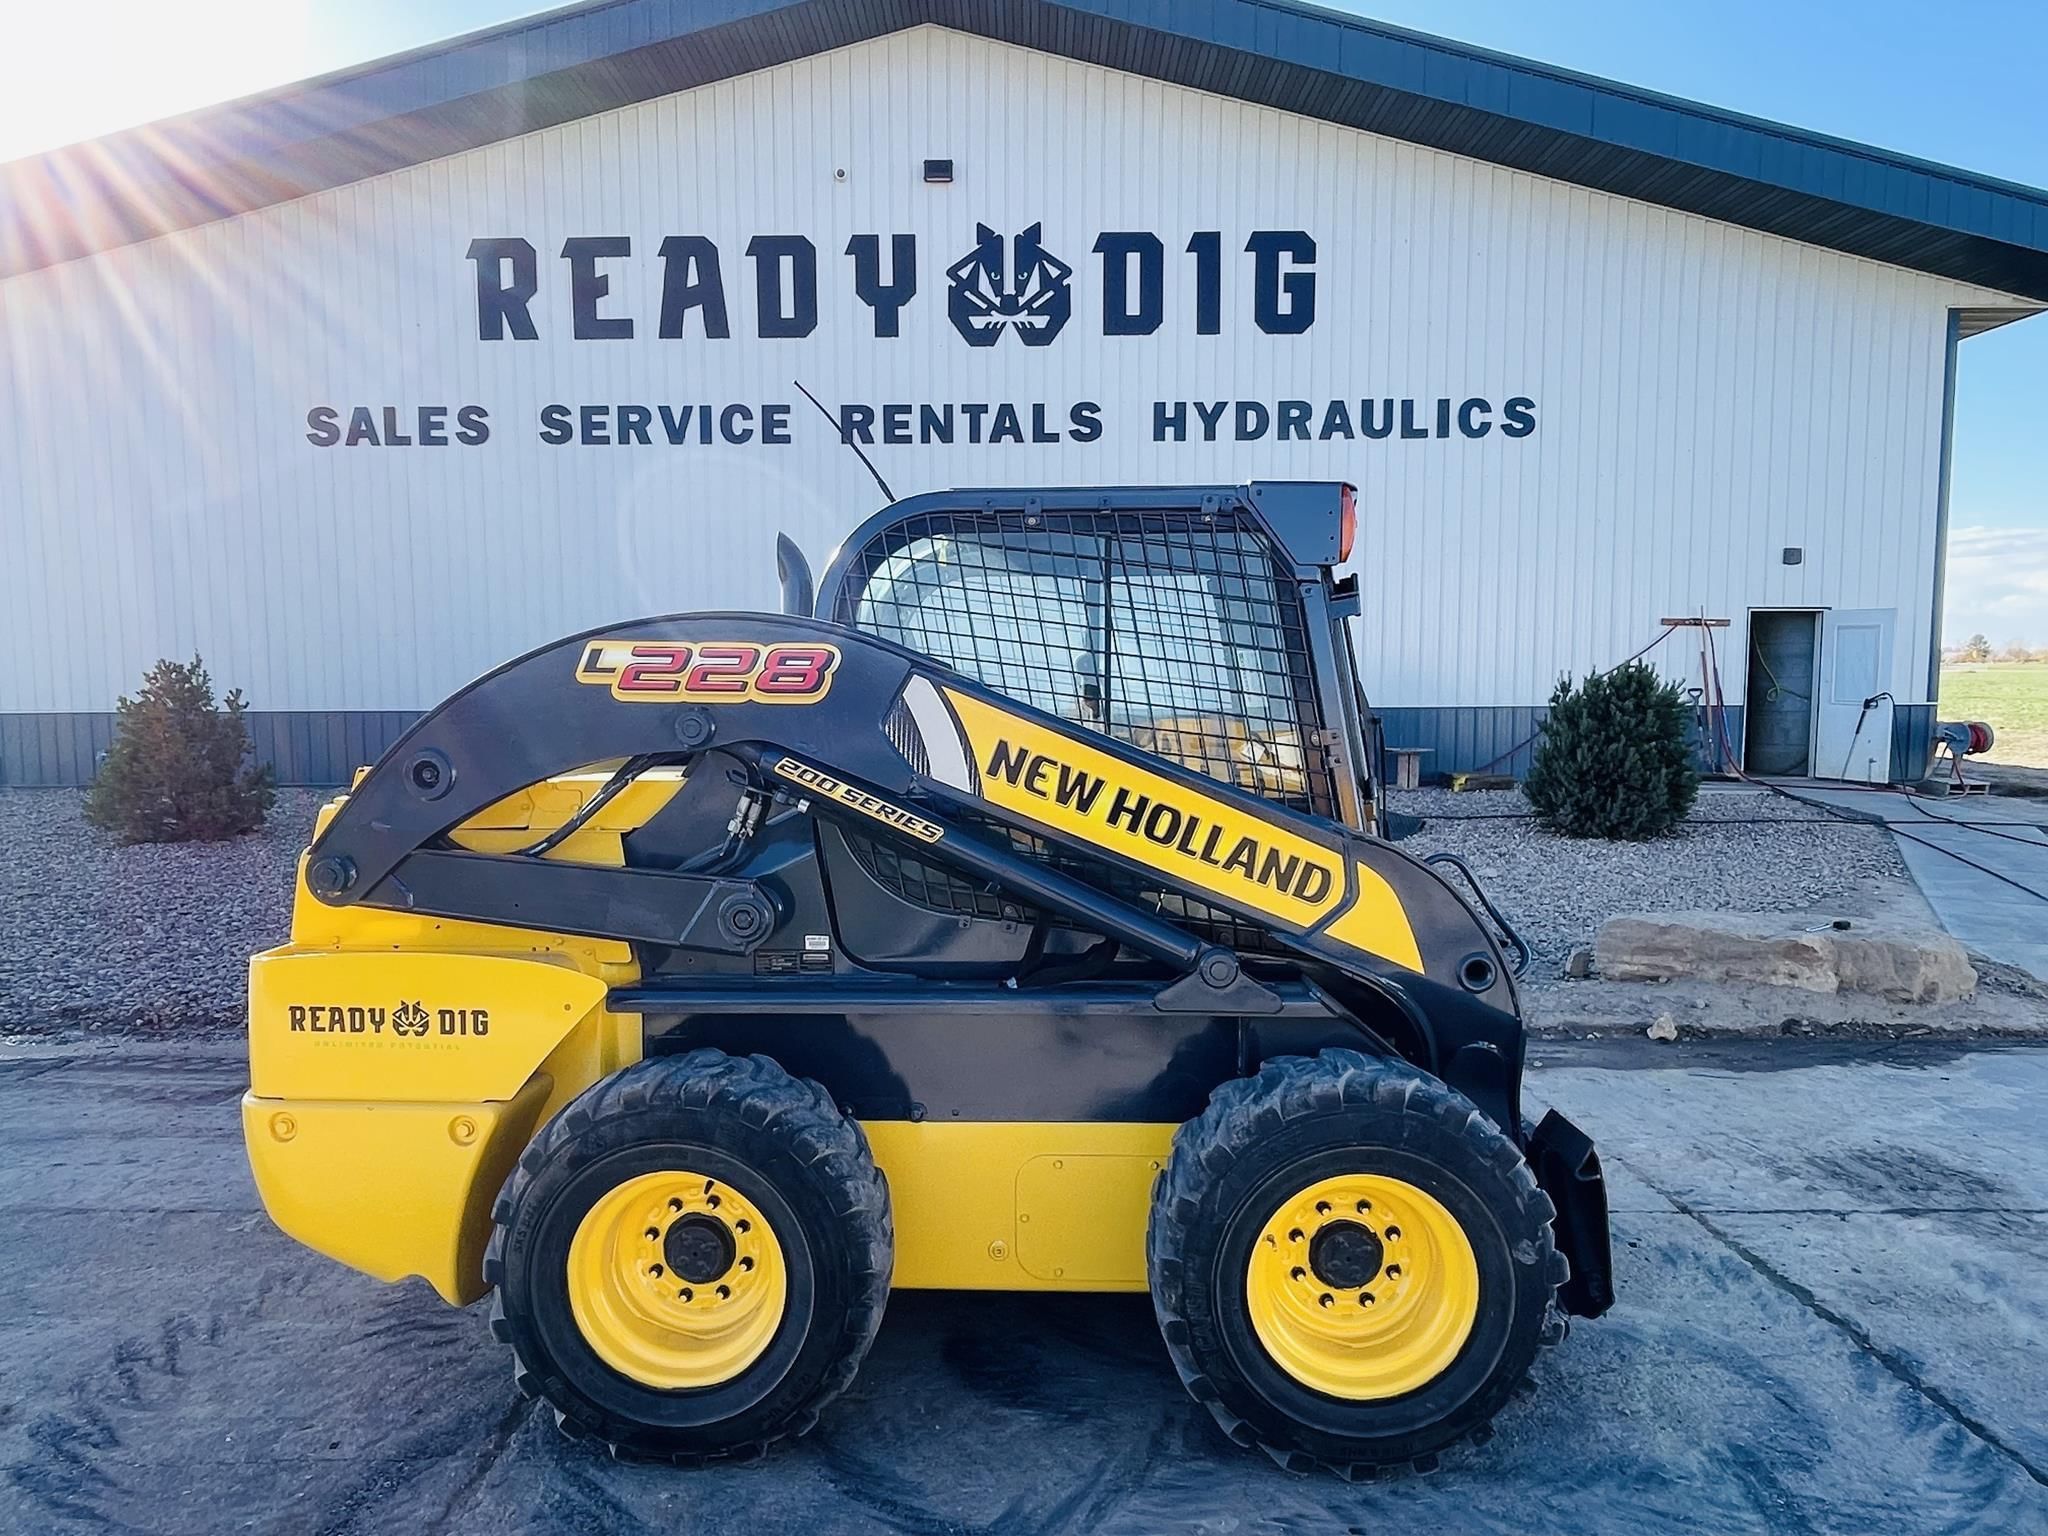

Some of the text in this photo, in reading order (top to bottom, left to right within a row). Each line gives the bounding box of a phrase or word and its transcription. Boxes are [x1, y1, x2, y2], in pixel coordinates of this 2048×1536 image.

[466, 230, 1317, 340] READY DIG
[306, 396, 1537, 447] SALES SERVICE RENTALS HYDRAULICS
[578, 643, 836, 698] L228
[777, 757, 944, 841] 200 SERIES
[985, 738, 1333, 904] NEW HOLLAND
[288, 1005, 489, 1036] READY DIG
